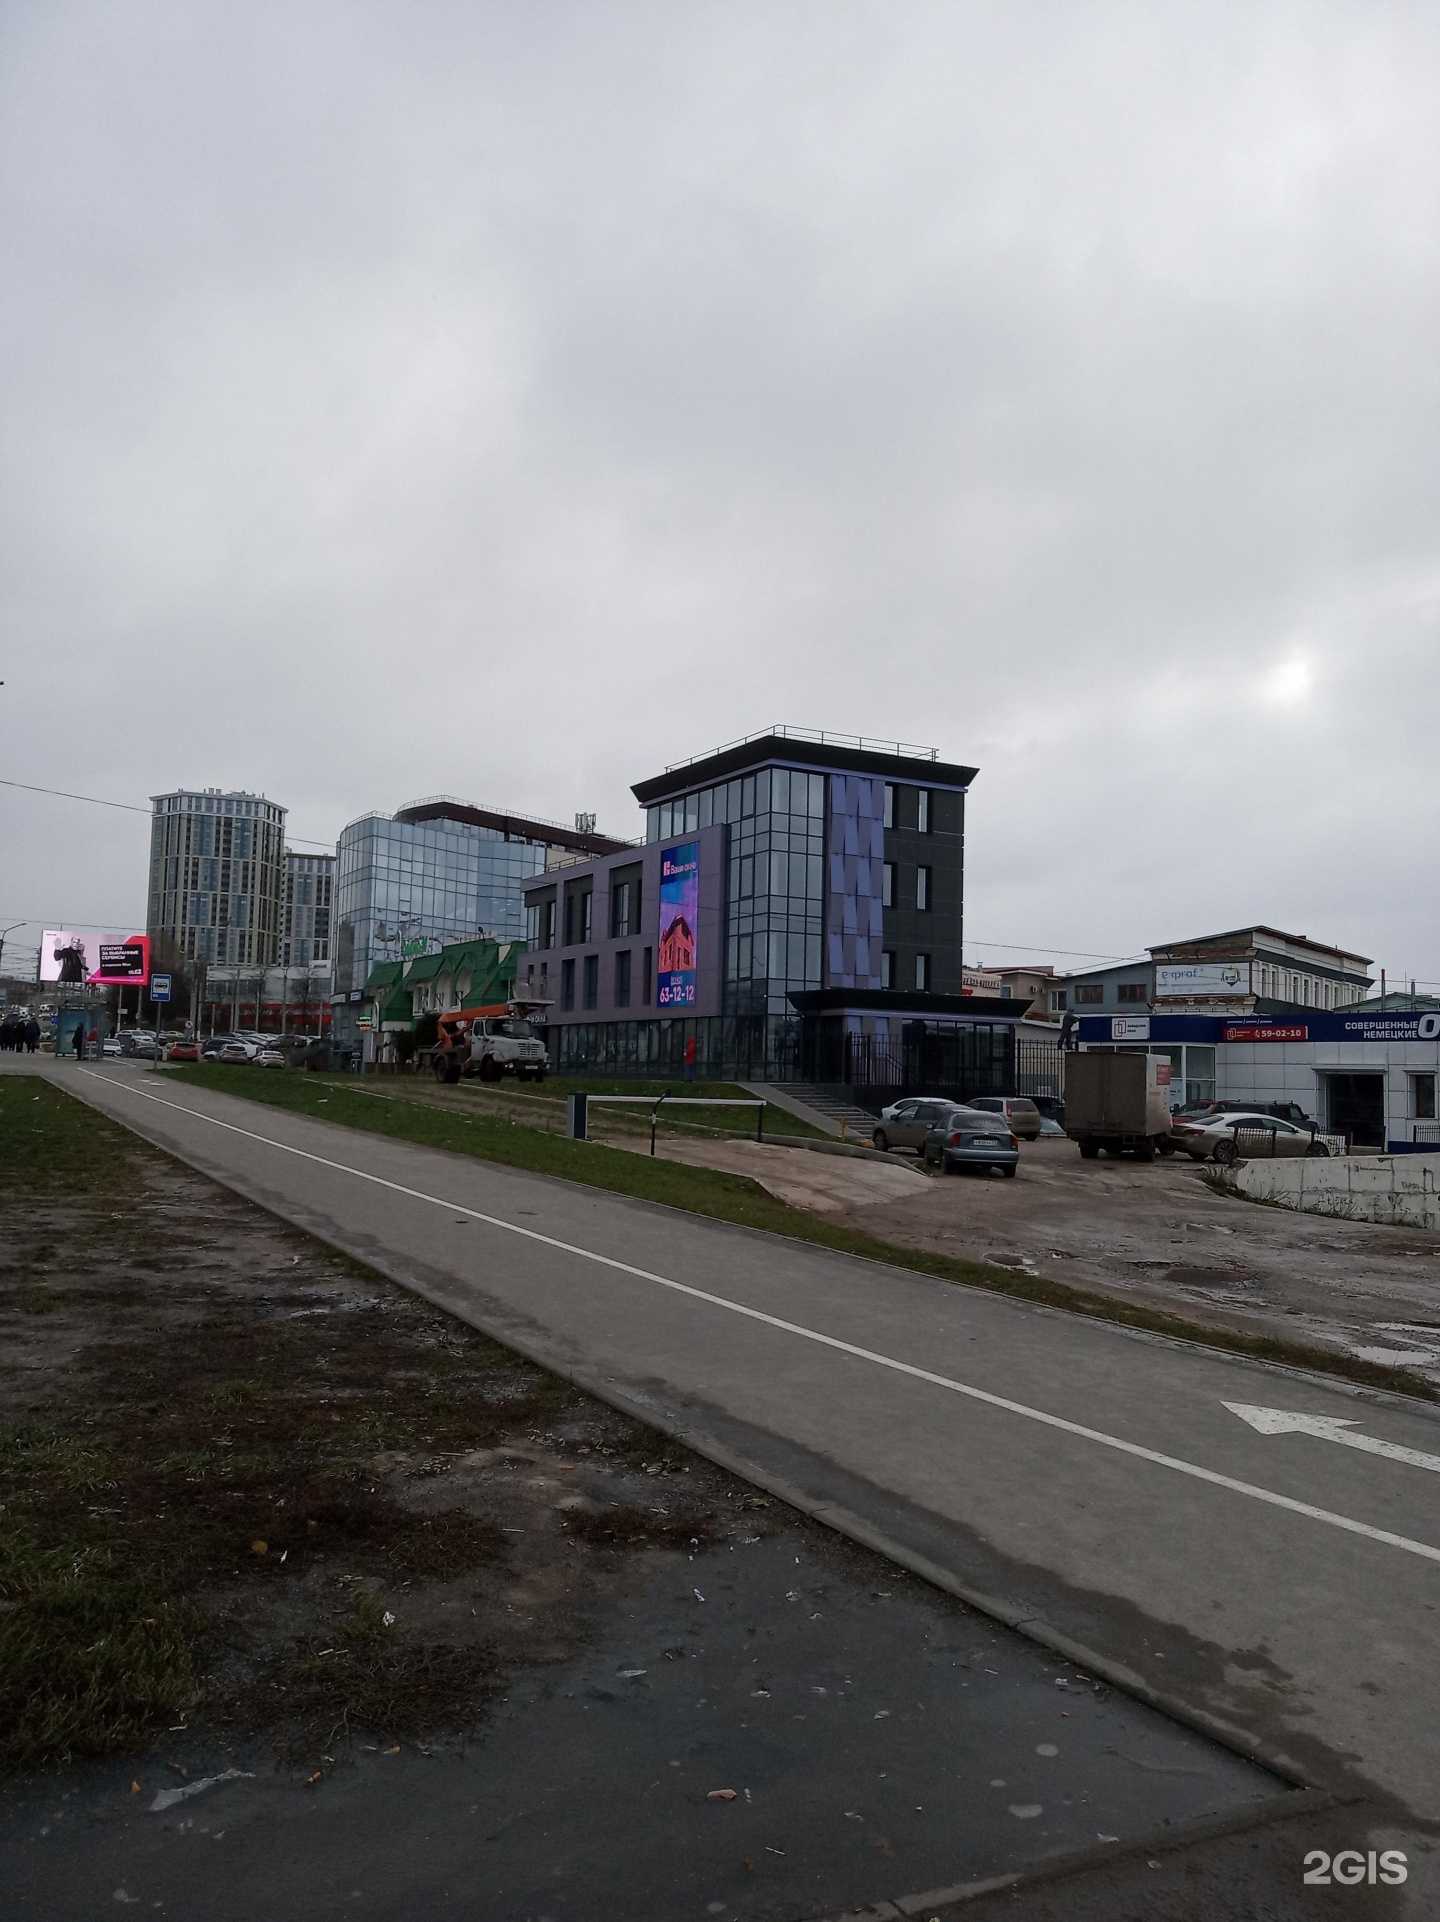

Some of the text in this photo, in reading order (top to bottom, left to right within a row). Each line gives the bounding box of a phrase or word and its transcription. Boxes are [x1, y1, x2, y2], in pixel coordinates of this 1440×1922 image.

[660, 984, 695, 1003] 63-12-12
[1345, 1021, 1418, 1030] СОВЕРШЕННЫЕ
[1261, 1029, 1302, 1038] 59-02-10
[1363, 1030, 1417, 1039] НЕМЕЦКИЕ
